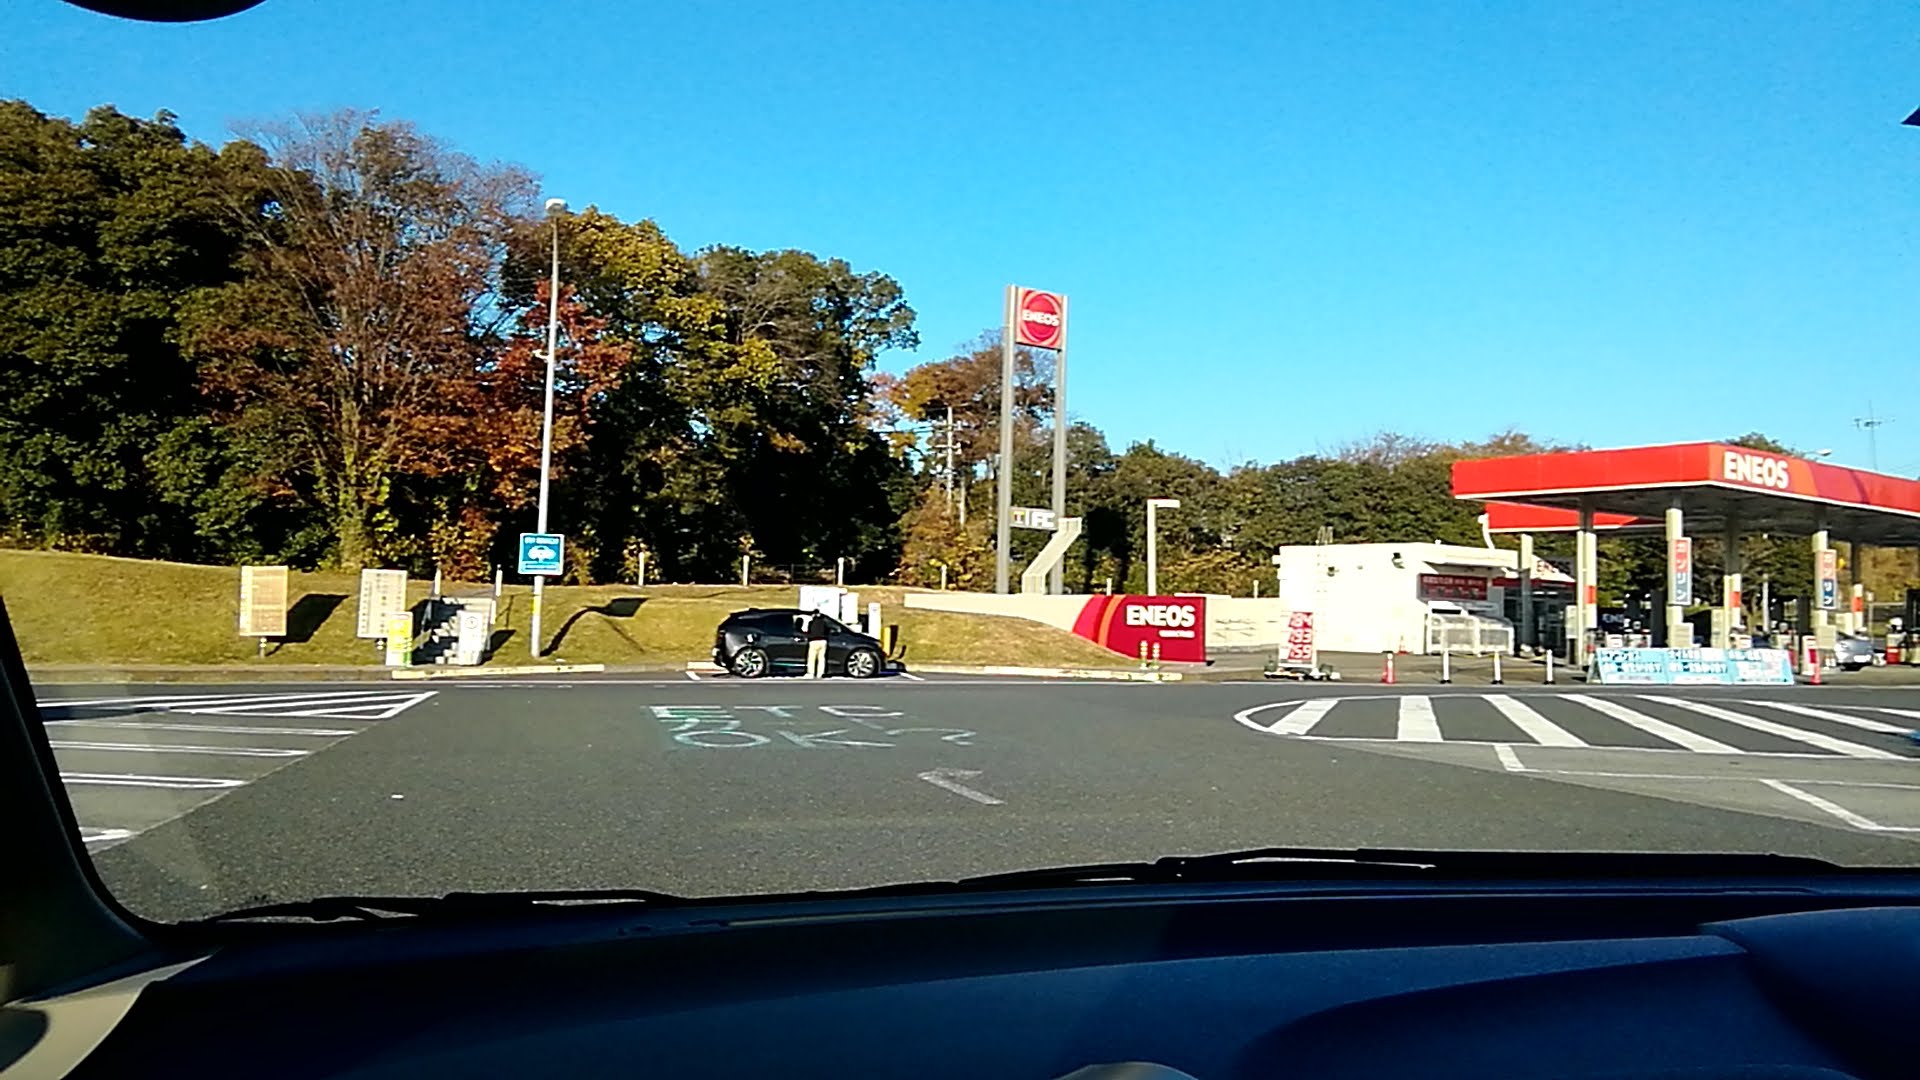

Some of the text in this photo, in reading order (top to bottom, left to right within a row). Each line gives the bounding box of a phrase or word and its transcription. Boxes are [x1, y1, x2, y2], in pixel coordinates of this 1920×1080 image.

[1022, 309, 1060, 327] ENEOS
[1723, 450, 1789, 489] ENEOS
[1126, 604, 1196, 627] ENEOS
[650, 704, 904, 718] ETC
